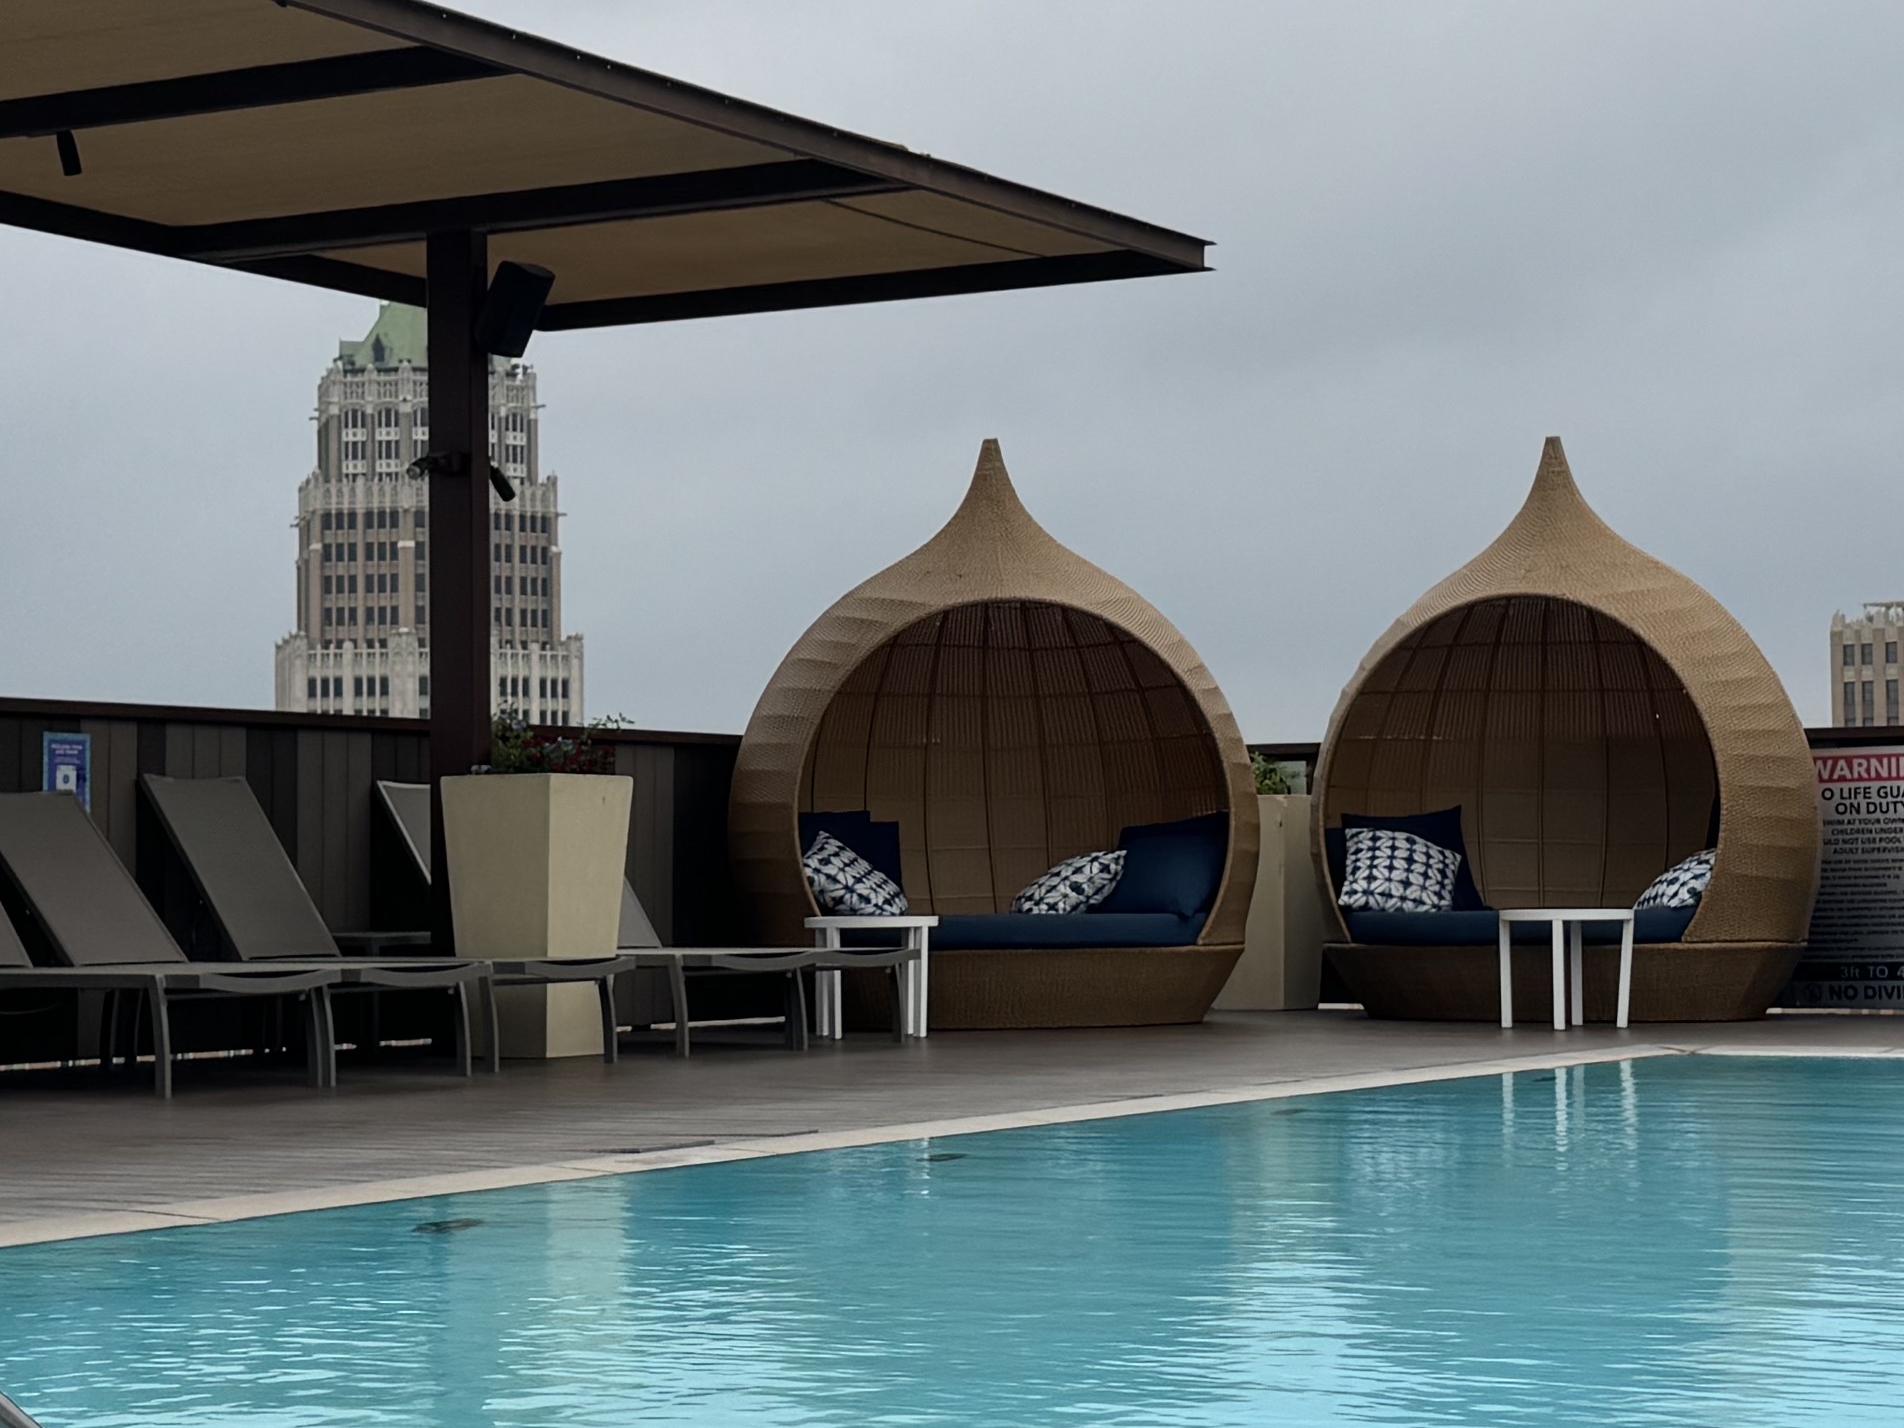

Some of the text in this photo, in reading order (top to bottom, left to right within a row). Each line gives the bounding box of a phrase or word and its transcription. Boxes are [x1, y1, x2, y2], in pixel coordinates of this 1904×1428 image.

[1821, 787, 1834, 801] O
[1839, 786, 1872, 800] LIFE
[1835, 802, 1861, 815] ON
[1840, 965, 1859, 978] 3ft
[1867, 965, 1889, 978] TO
[1828, 984, 1858, 1001] NO
